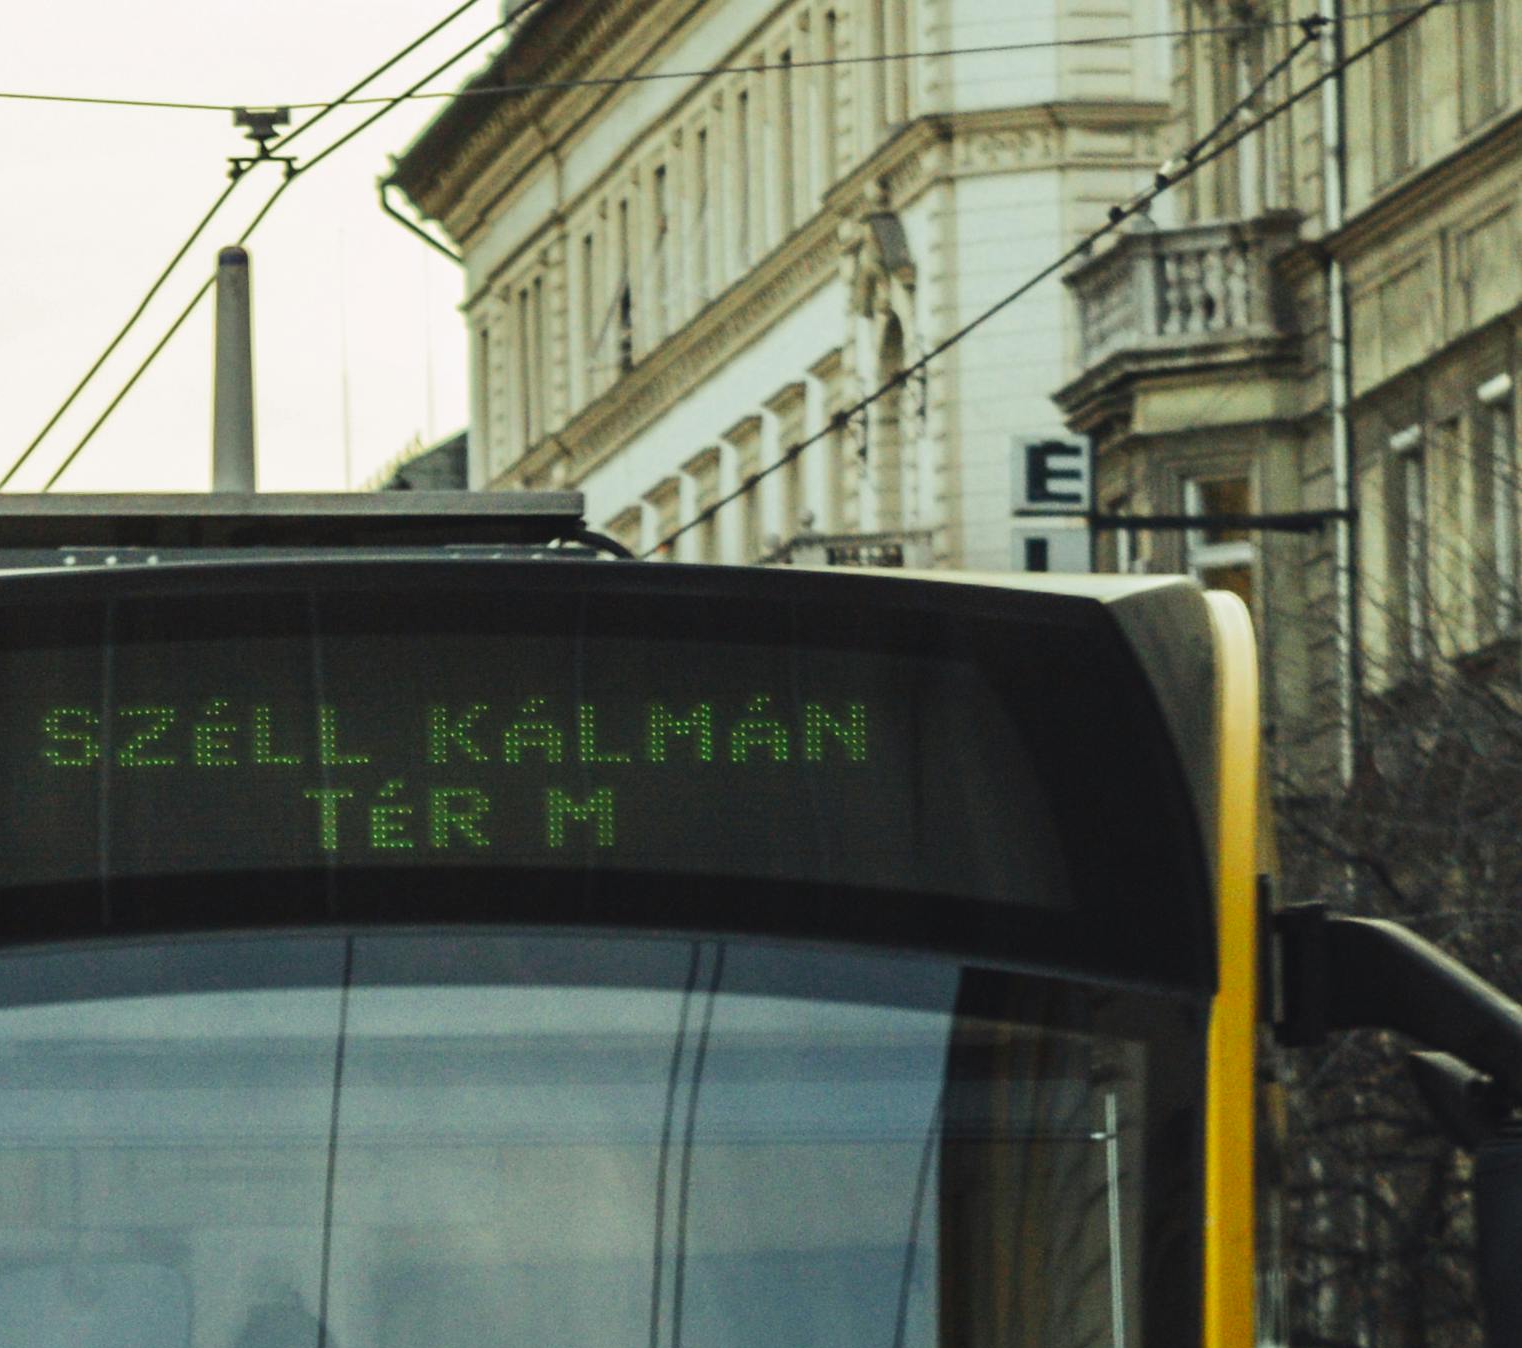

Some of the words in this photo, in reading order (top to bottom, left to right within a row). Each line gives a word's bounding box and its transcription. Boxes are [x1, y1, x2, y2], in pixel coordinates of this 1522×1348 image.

[43, 699, 371, 767] SZÉLL
[429, 696, 866, 764] KÁLMÁN
[306, 779, 492, 850] TÉR
[547, 787, 615, 848] M
